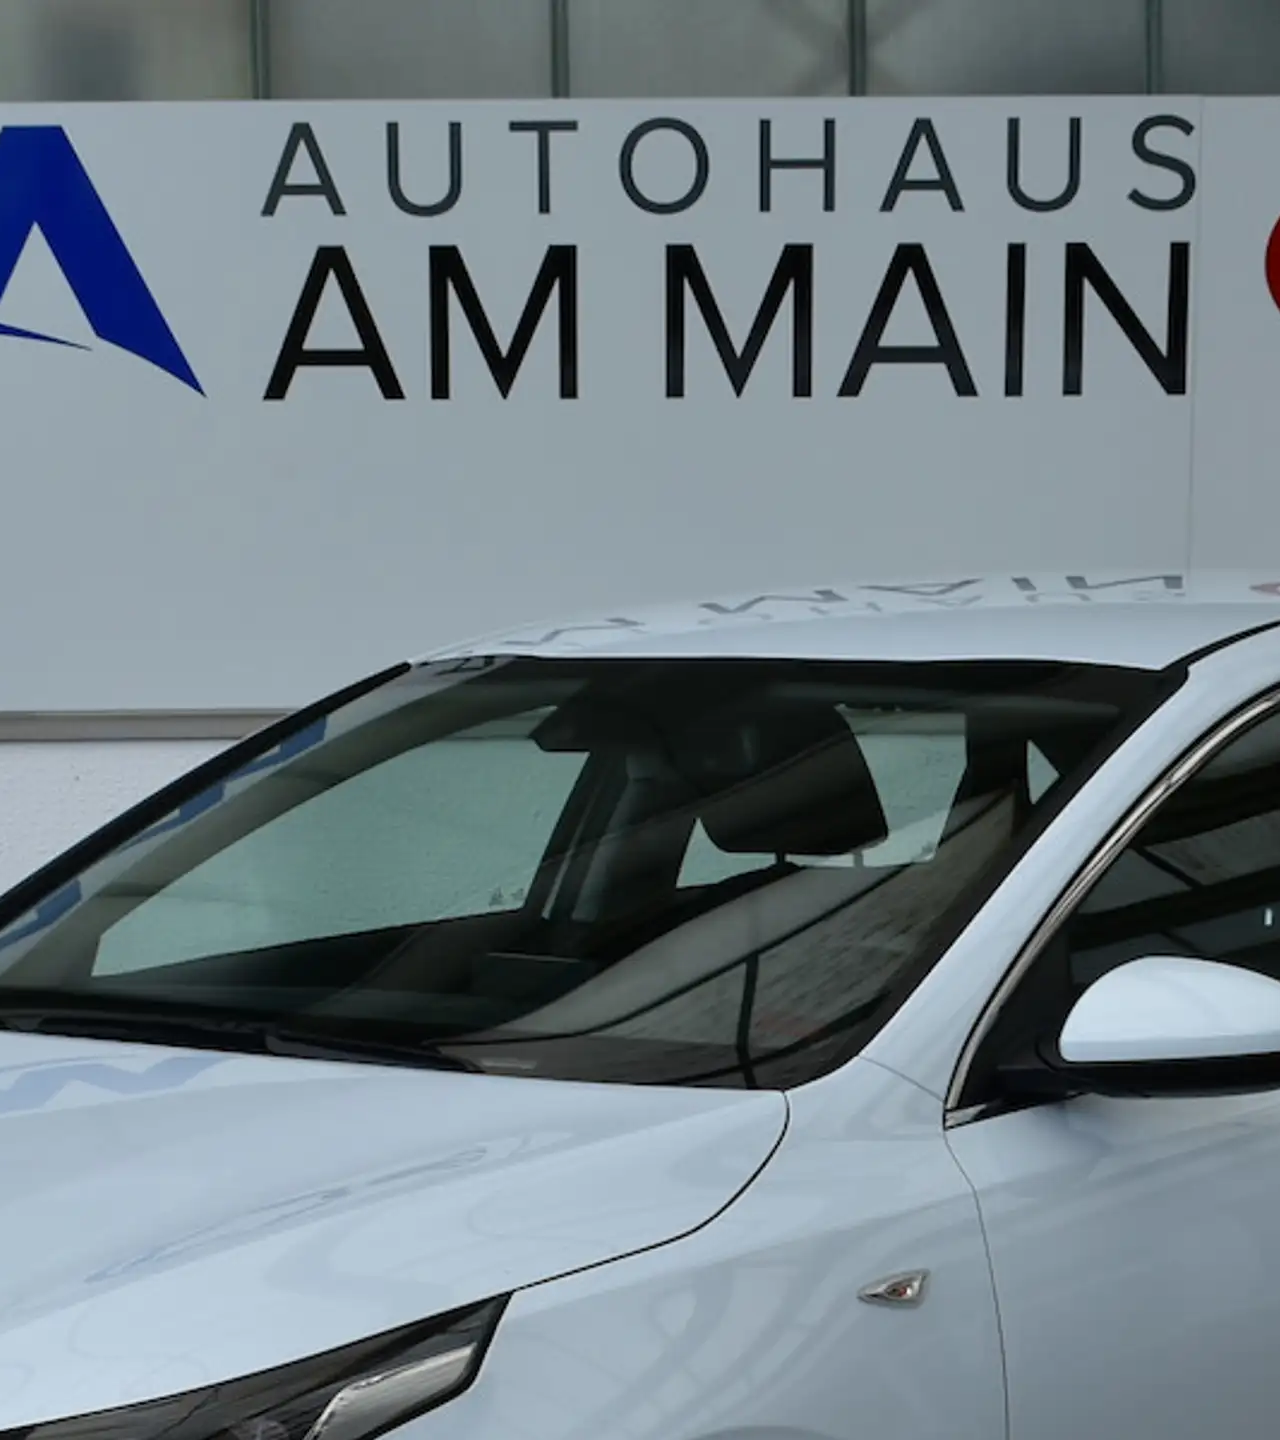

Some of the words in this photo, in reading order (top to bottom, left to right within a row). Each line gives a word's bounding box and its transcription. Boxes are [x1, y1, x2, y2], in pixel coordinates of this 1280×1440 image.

[261, 114, 1198, 218] AUTOHAUS
[262, 242, 580, 401] AM
[663, 241, 1191, 399] MAIN
